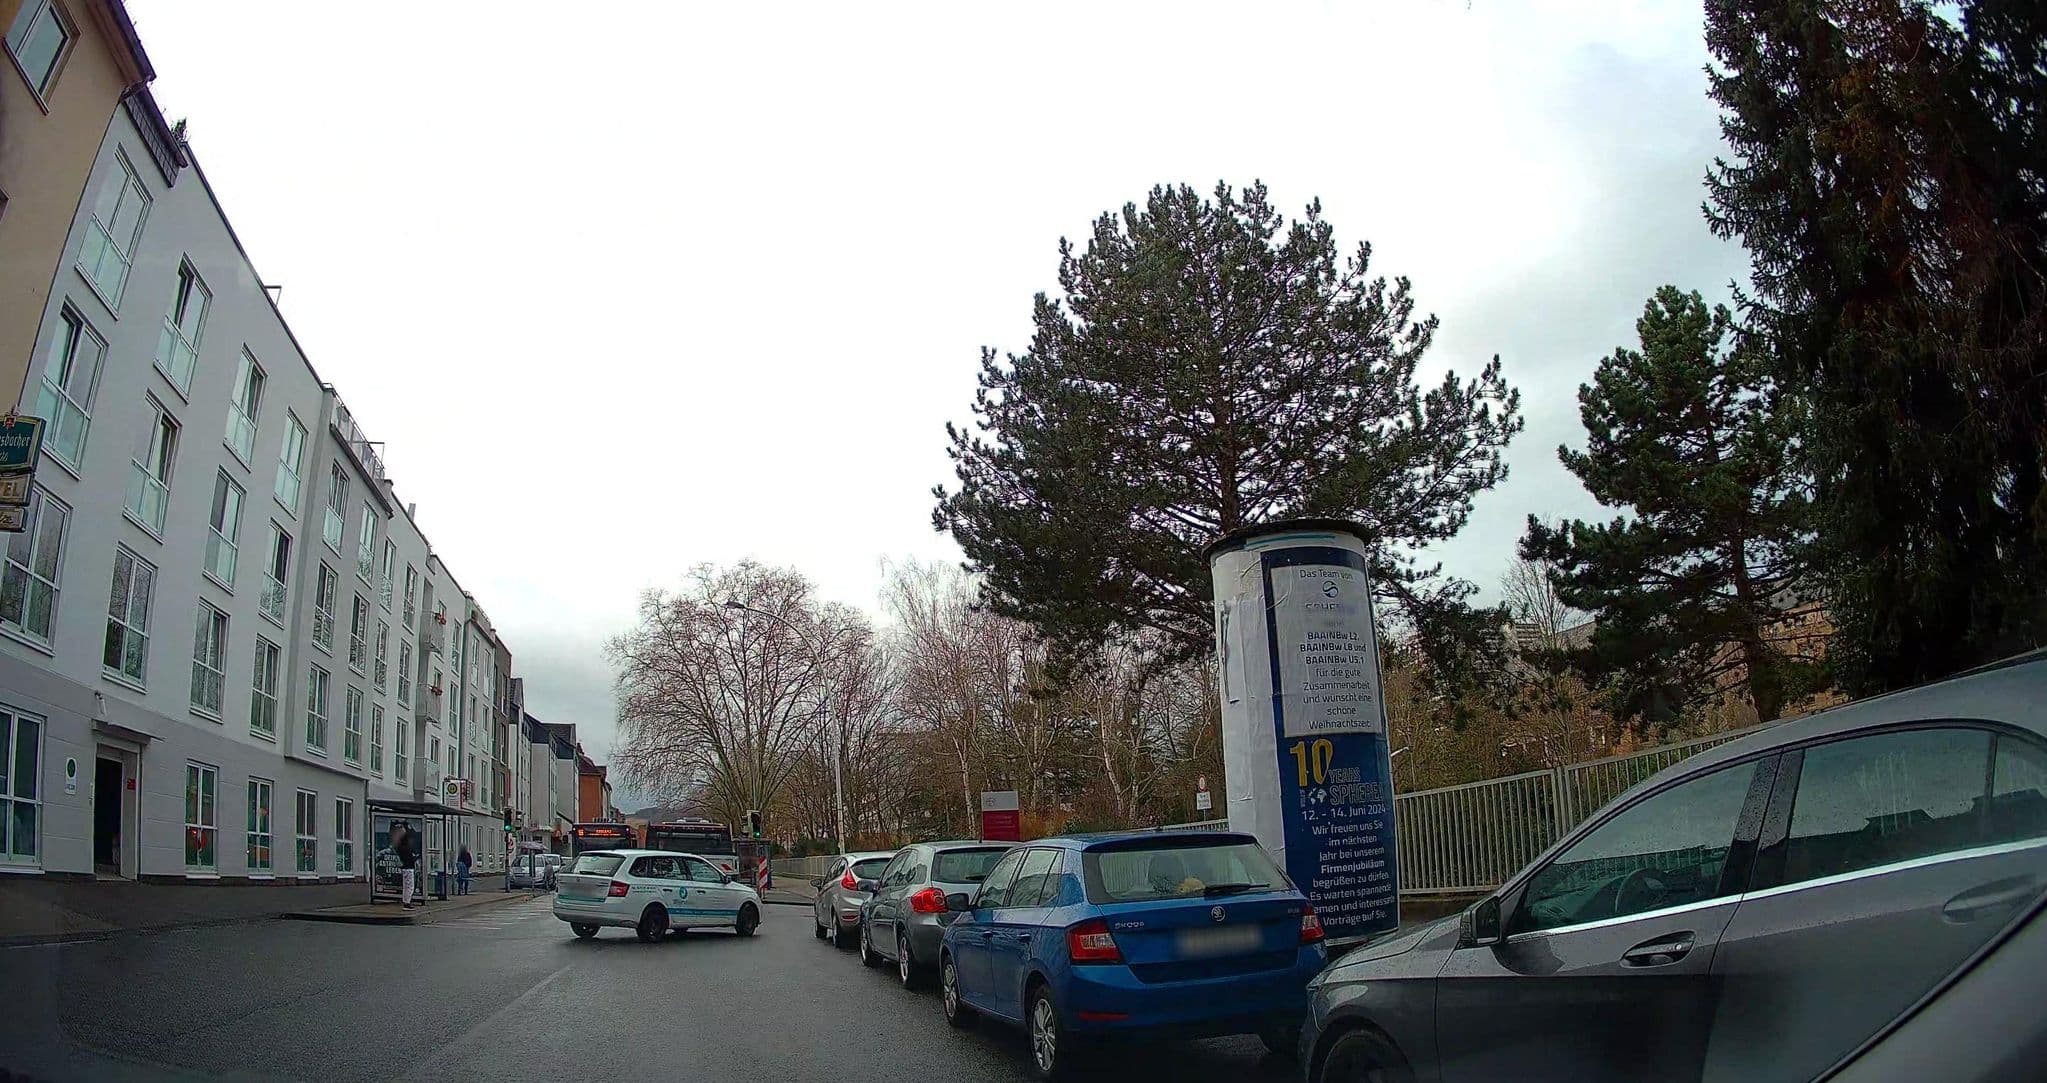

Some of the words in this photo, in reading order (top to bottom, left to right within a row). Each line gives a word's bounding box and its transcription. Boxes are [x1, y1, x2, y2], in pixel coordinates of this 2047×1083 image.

[1300, 569, 1317, 578] Das
[1319, 569, 1340, 578] Team
[1307, 632, 1348, 640] BAAINBw
[1300, 642, 1342, 652] BAAINBw
[1354, 643, 1366, 652] und
[1305, 655, 1347, 664] BAAINBw
[1316, 667, 1328, 677] für
[1331, 667, 1343, 677] die
[1344, 668, 1361, 679] gute
[1303, 681, 1370, 690] Zusammenarbeit
[1303, 694, 1320, 704] und
[1358, 693, 1372, 702] eine
[1289, 739, 1333, 787] 10
[1328, 767, 1361, 784] YEARS
[1302, 810, 1319, 820] 12.
[1331, 807, 1347, 818] 14.
[1349, 806, 1366, 818] Juni
[1367, 804, 1386, 815] 2024
[1312, 825, 1328, 835] Wir
[1331, 823, 1358, 834] freuen
[1360, 822, 1373, 831] uns
[1328, 838, 1340, 847] im
[1342, 835, 1378, 845] nächsten
[1319, 851, 1338, 862] Jahr
[1339, 849, 1353, 859] bei
[1354, 847, 1385, 858] unserem
[1321, 859, 1385, 874] Firmenjubiläum
[1312, 876, 1356, 889] begrüßen
[1357, 875, 1367, 883] zu
[1310, 891, 1321, 901] Es
[1323, 889, 1355, 900] warten
[1314, 905, 1339, 914] emen
[1341, 901, 1358, 911] und
[1323, 914, 1361, 926] Vorträge
[1361, 911, 1374, 921] auf
